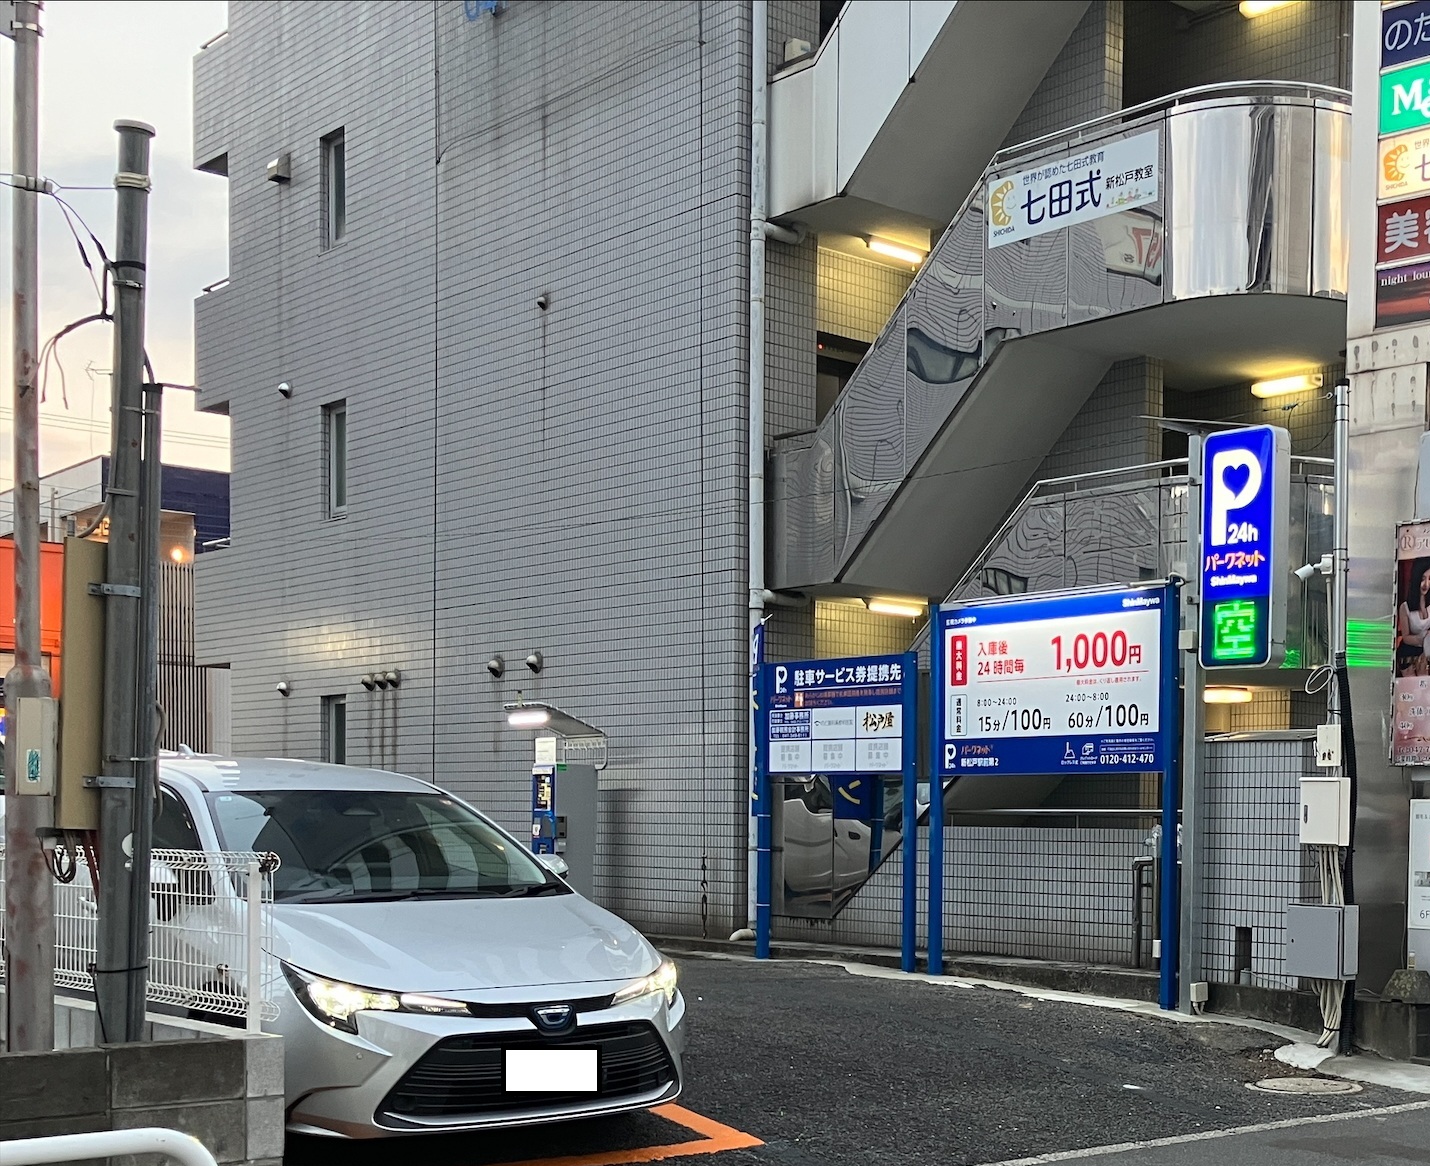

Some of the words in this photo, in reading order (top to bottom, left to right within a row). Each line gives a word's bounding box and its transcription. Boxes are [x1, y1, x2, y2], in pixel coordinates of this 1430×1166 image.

[1022, 151, 1105, 187] 世界が認めた七田式教育
[1105, 164, 1154, 190] 新松戸教室
[1385, 181, 1409, 190] SHICHIDA
[1020, 169, 1101, 225] 七田式
[993, 226, 1015, 238] SHICHIDA
[1381, 274, 1407, 287] night
[1227, 522, 1258, 543] 24h
[1204, 550, 1265, 573] パークネット
[1122, 597, 1160, 608] ShinMaywa
[978, 641, 1008, 656] 入庫後
[1051, 630, 1142, 673] 1,000円
[794, 663, 901, 687] 駐車サービス券提携先
[978, 661, 990, 675] 24
[993, 658, 1024, 675] 時間毎
[1420, 910, 1430, 919] 6F
